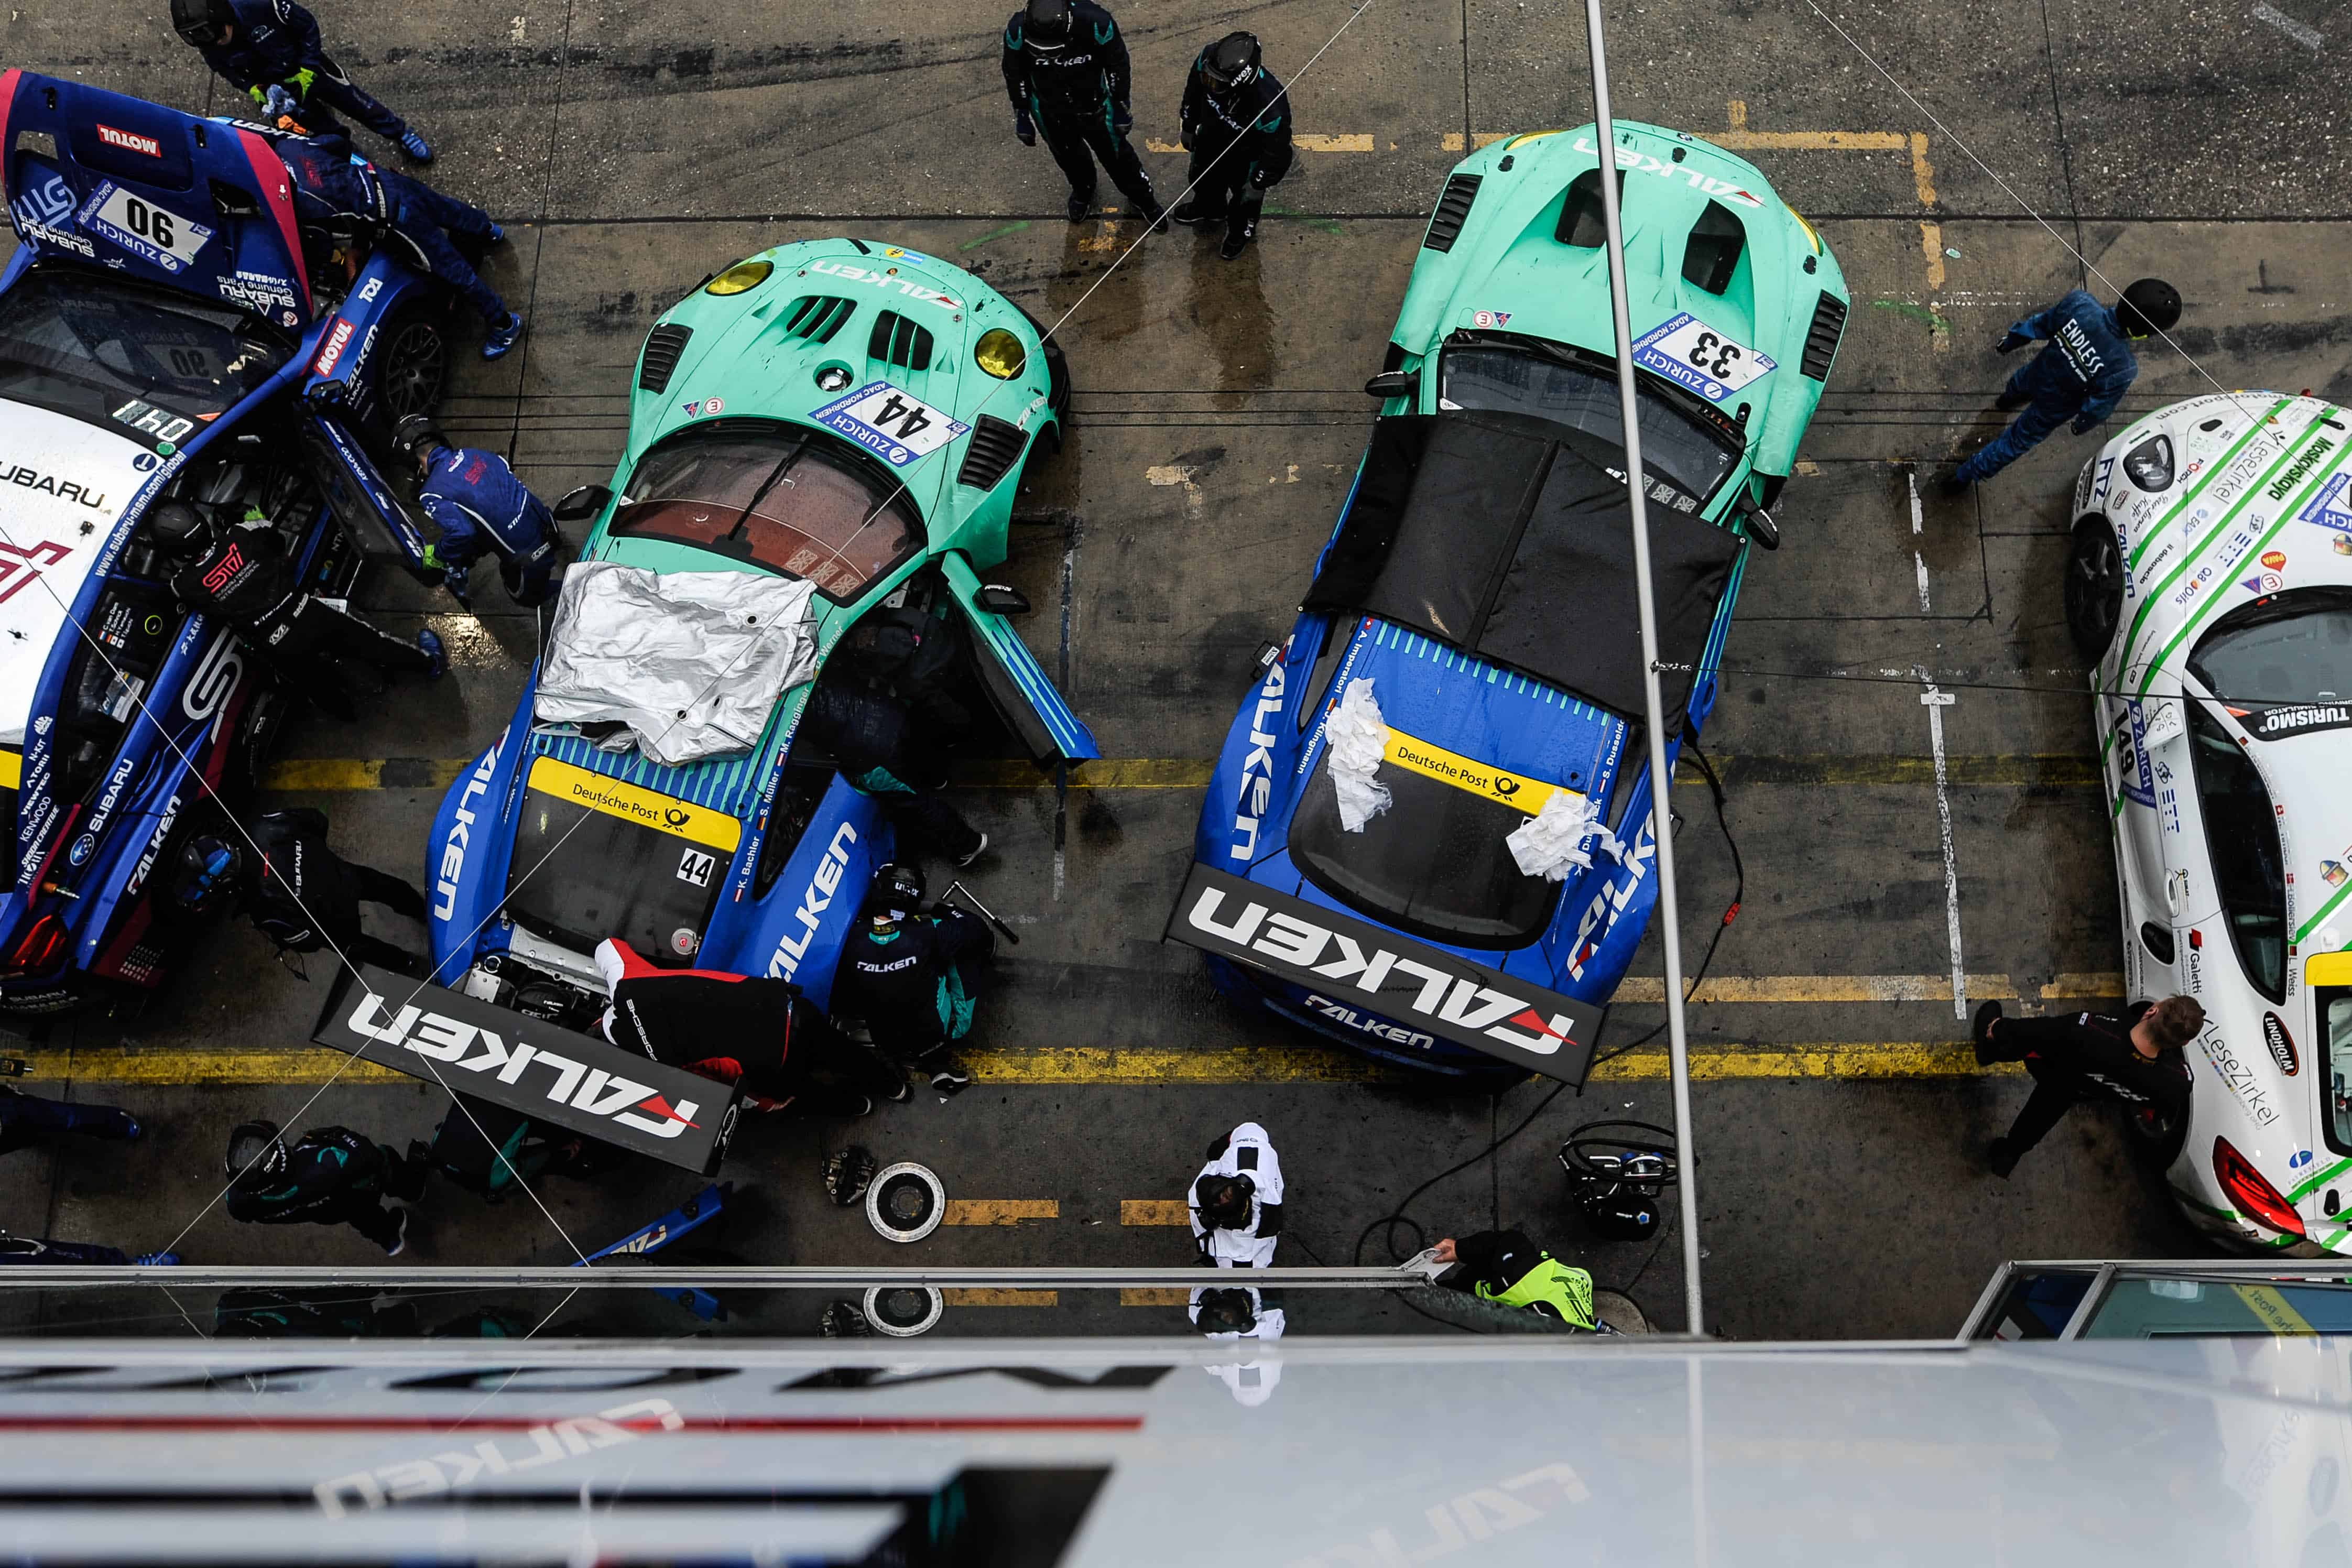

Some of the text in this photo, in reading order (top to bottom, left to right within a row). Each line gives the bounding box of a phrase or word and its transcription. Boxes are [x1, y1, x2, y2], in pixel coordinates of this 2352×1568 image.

[1230, 64, 1253, 88] uvex
[100, 127, 157, 154] MOTUL
[21, 221, 95, 257] SUBARU
[48, 225, 93, 248] Genuine
[96, 220, 157, 262] ZURICH
[126, 198, 174, 248] 90
[217, 276, 292, 297] Genuine Parts
[220, 284, 296, 308] SUBARU
[810, 260, 963, 311] FALKEN
[317, 322, 353, 374] MOTUL
[1632, 313, 1690, 355] ADAC NORDRHE
[1689, 332, 1741, 380] 33
[2062, 318, 2105, 377] ENDLESS
[346, 323, 378, 393] ALKEN
[1643, 351, 1703, 389] ZURICH
[815, 382, 888, 420] ADAC NORDRHEIN
[873, 394, 932, 440] 44
[833, 415, 896, 454] ZURICH
[0, 463, 106, 508] UBARU
[2094, 456, 2116, 503] FTZ
[2214, 440, 2279, 505] LeseZirkel
[2268, 437, 2334, 502] Moskovskaya
[2118, 523, 2137, 599] FALKEN
[2172, 565, 2215, 608] Q8 Oils
[820, 626, 844, 661] Werner
[1334, 629, 1368, 694] A. Imperatori
[780, 688, 810, 754] M. Ragginger
[2113, 707, 2136, 777] 149
[2266, 710, 2350, 732] TURISMO
[1297, 722, 1327, 775] Klingmann
[1397, 746, 1489, 789] Deutsche Post
[2135, 727, 2152, 788] ZURICH
[90, 759, 133, 832] SUBARU
[760, 771, 780, 816] S. Müller
[1602, 768, 1611, 779] S.
[20, 796, 51, 842] KENWOOD
[573, 783, 659, 821] Deutsche Post
[128, 795, 181, 896] FALKEN
[738, 836, 760, 890] K. Bachler
[680, 854, 713, 884] 44
[764, 821, 858, 981] ALKEN
[857, 955, 917, 973] FALKEN
[1189, 886, 1577, 1054] FALKEN
[2190, 952, 2203, 994] Galetti
[2288, 968, 2298, 997] Weiss
[626, 998, 658, 1062] PORSCHE
[1304, 994, 1434, 1049] FALKEN
[2266, 1016, 2296, 1072] LINDHOLM
[348, 992, 701, 1139] FALKEN
[2203, 1025, 2280, 1127] LeseZirkel
